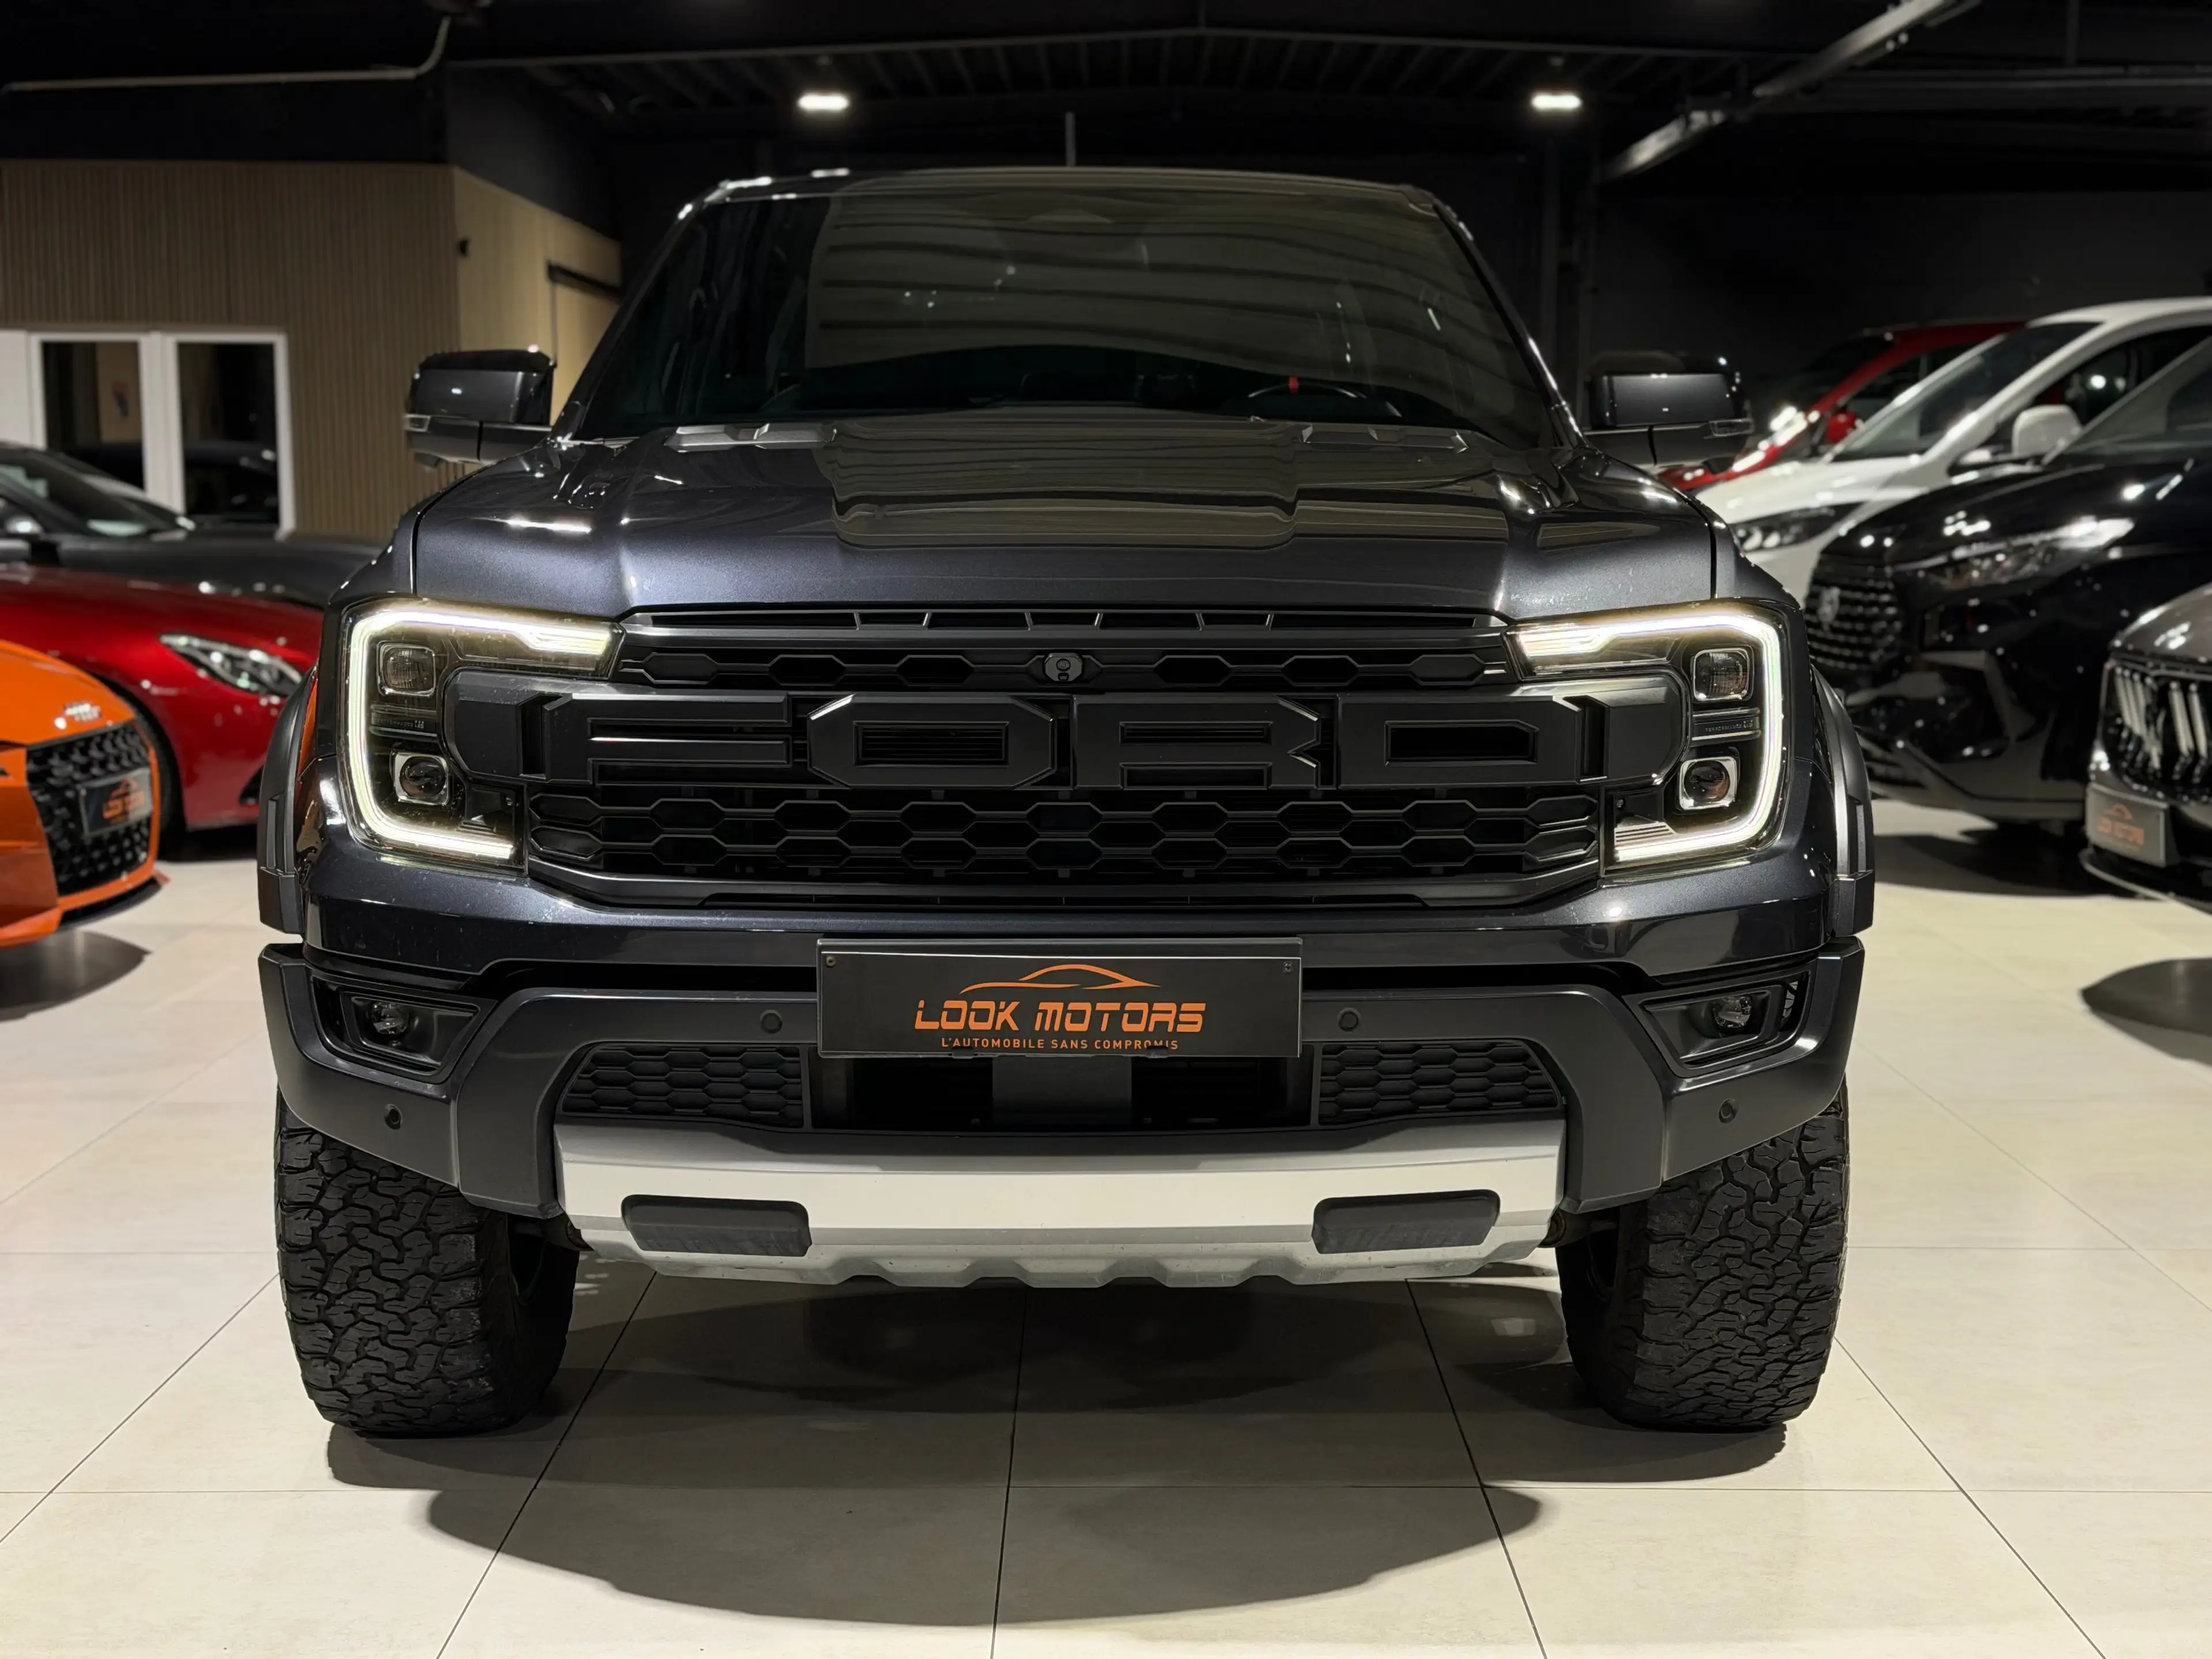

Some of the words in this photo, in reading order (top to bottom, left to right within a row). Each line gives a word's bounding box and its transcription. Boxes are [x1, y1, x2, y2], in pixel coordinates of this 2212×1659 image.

[544, 692, 1584, 790] FORD
[915, 1000, 1020, 1031] LOOK
[1035, 1002, 1206, 1033] MOTORS
[941, 1037, 1044, 1048] L'AUTOMOBILE
[1051, 1039, 1088, 1049] SANS
